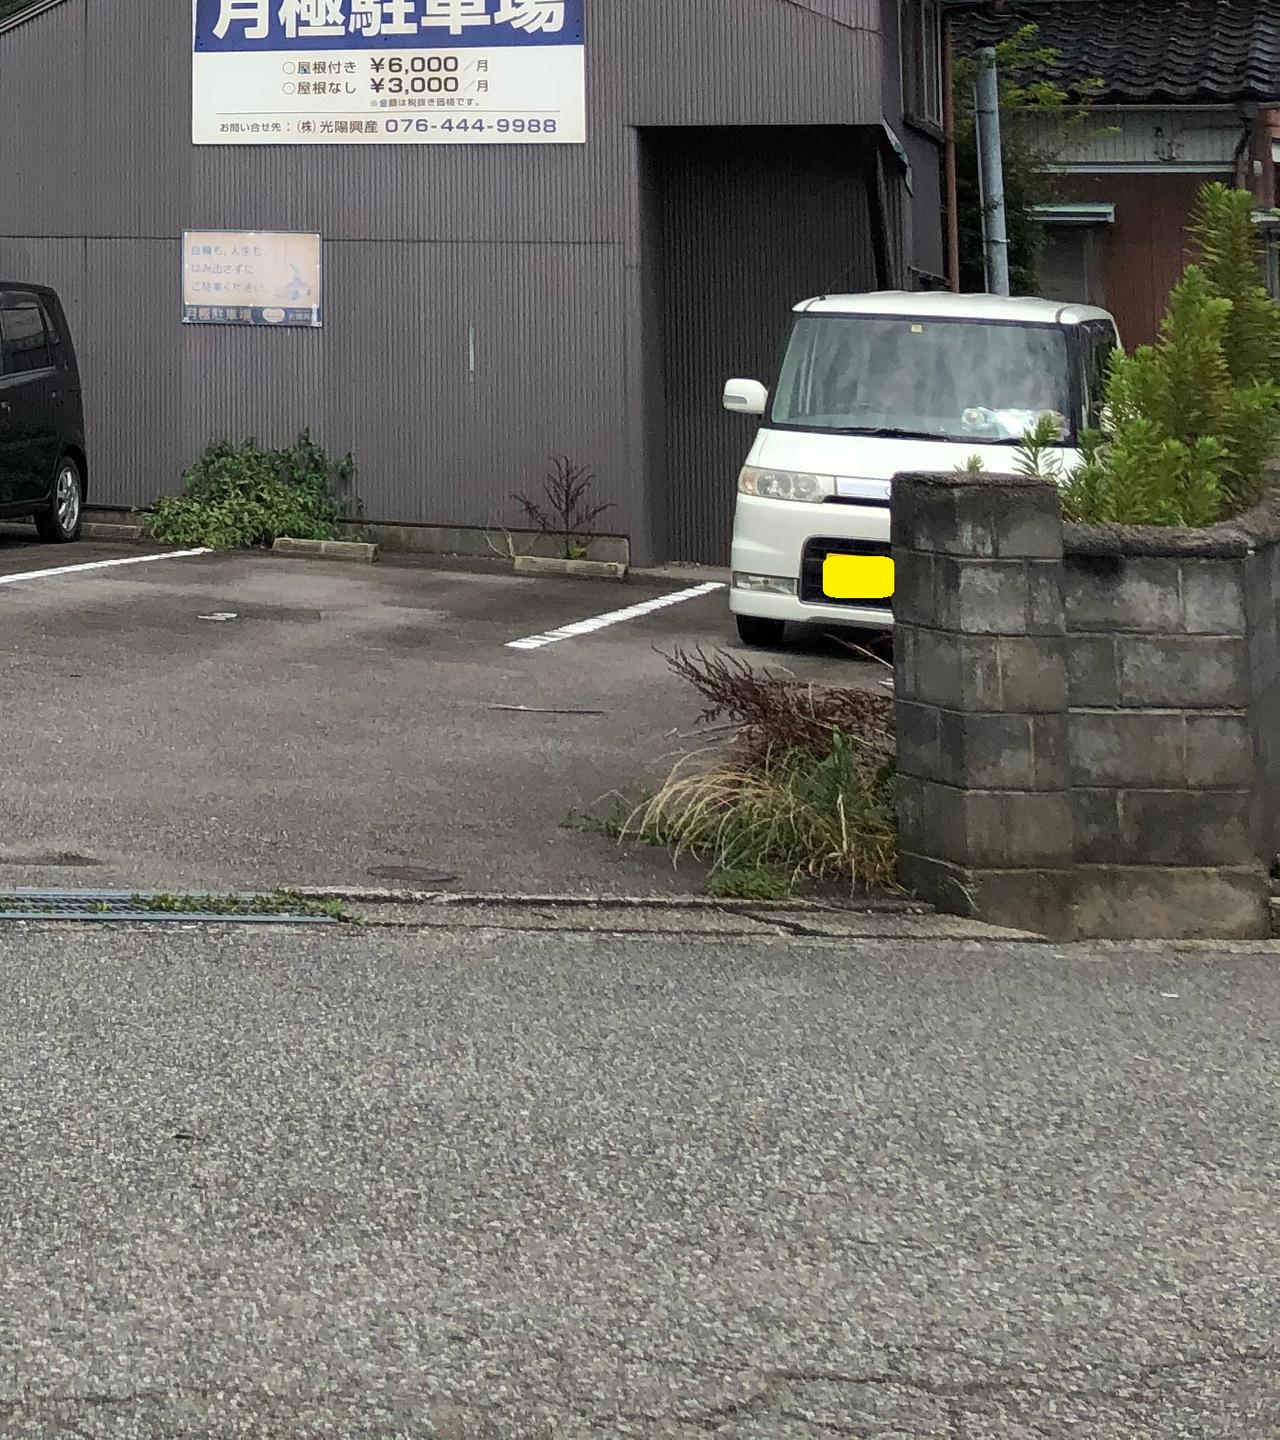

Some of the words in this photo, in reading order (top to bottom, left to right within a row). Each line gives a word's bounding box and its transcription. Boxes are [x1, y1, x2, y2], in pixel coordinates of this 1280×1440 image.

[369, 56, 459, 75] ¥6,000
[369, 76, 459, 95] ¥3,000
[385, 118, 557, 133] 076-444-9988
